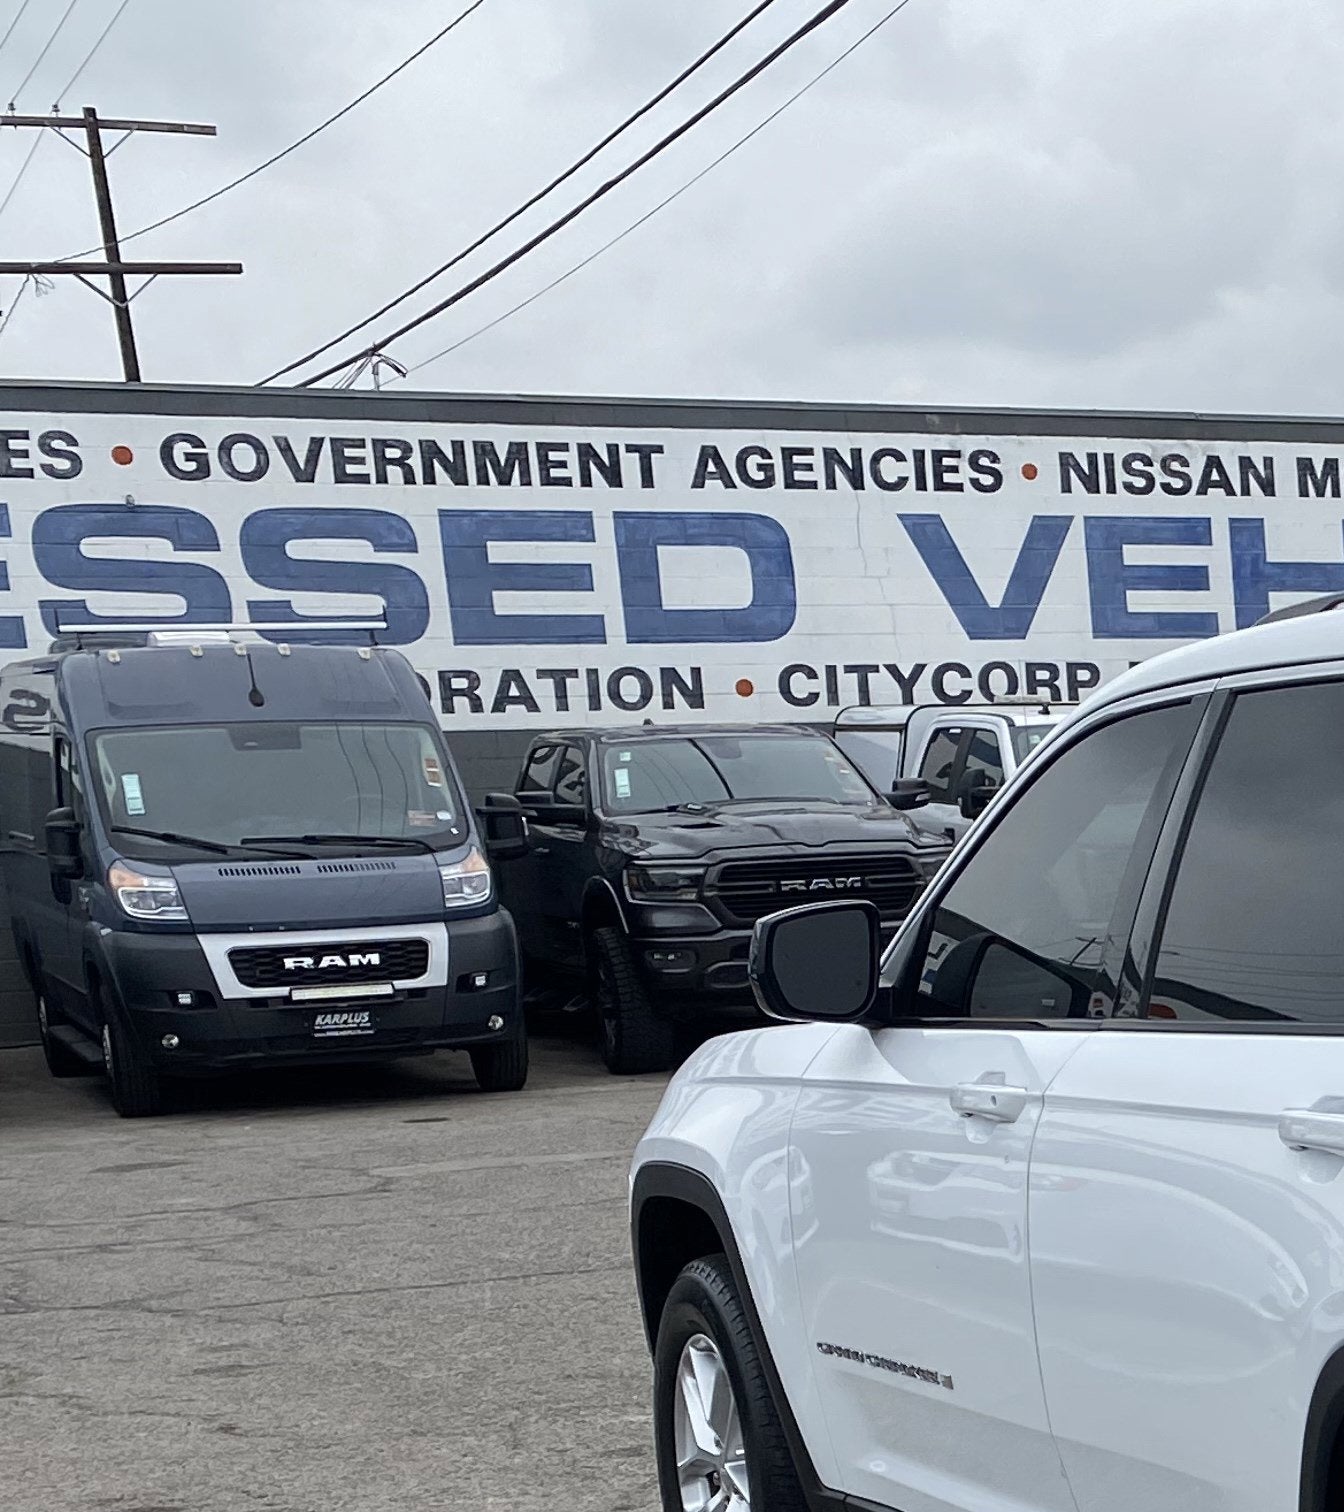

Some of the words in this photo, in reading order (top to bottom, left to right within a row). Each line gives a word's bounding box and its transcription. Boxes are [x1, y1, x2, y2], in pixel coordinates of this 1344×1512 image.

[158, 432, 665, 489] GOVERNMENT
[691, 443, 1004, 494] AGENCIES
[1059, 450, 1275, 498] NISSAN
[780, 876, 862, 892] RAM
[283, 952, 381, 970] RAM
[315, 1011, 370, 1026] KARPLUS
